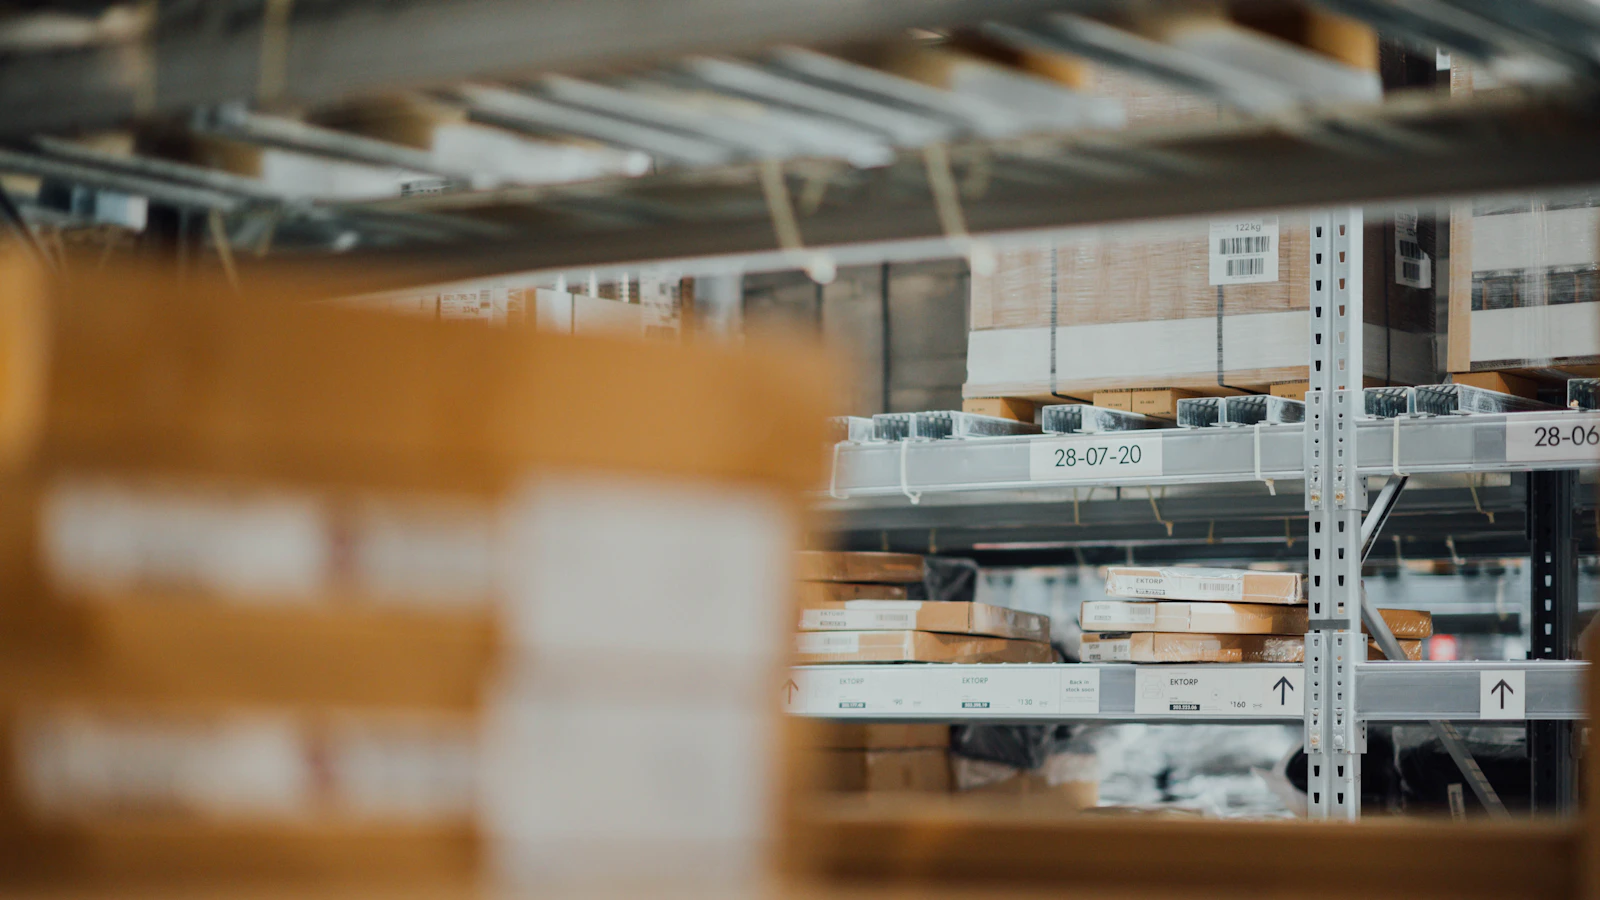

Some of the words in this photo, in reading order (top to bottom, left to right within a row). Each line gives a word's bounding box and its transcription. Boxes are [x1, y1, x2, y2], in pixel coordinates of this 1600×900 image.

[1534, 425, 1600, 447] 28-06
[1054, 444, 1142, 467] 28-07-20
[1169, 678, 1198, 686] EKTORP
